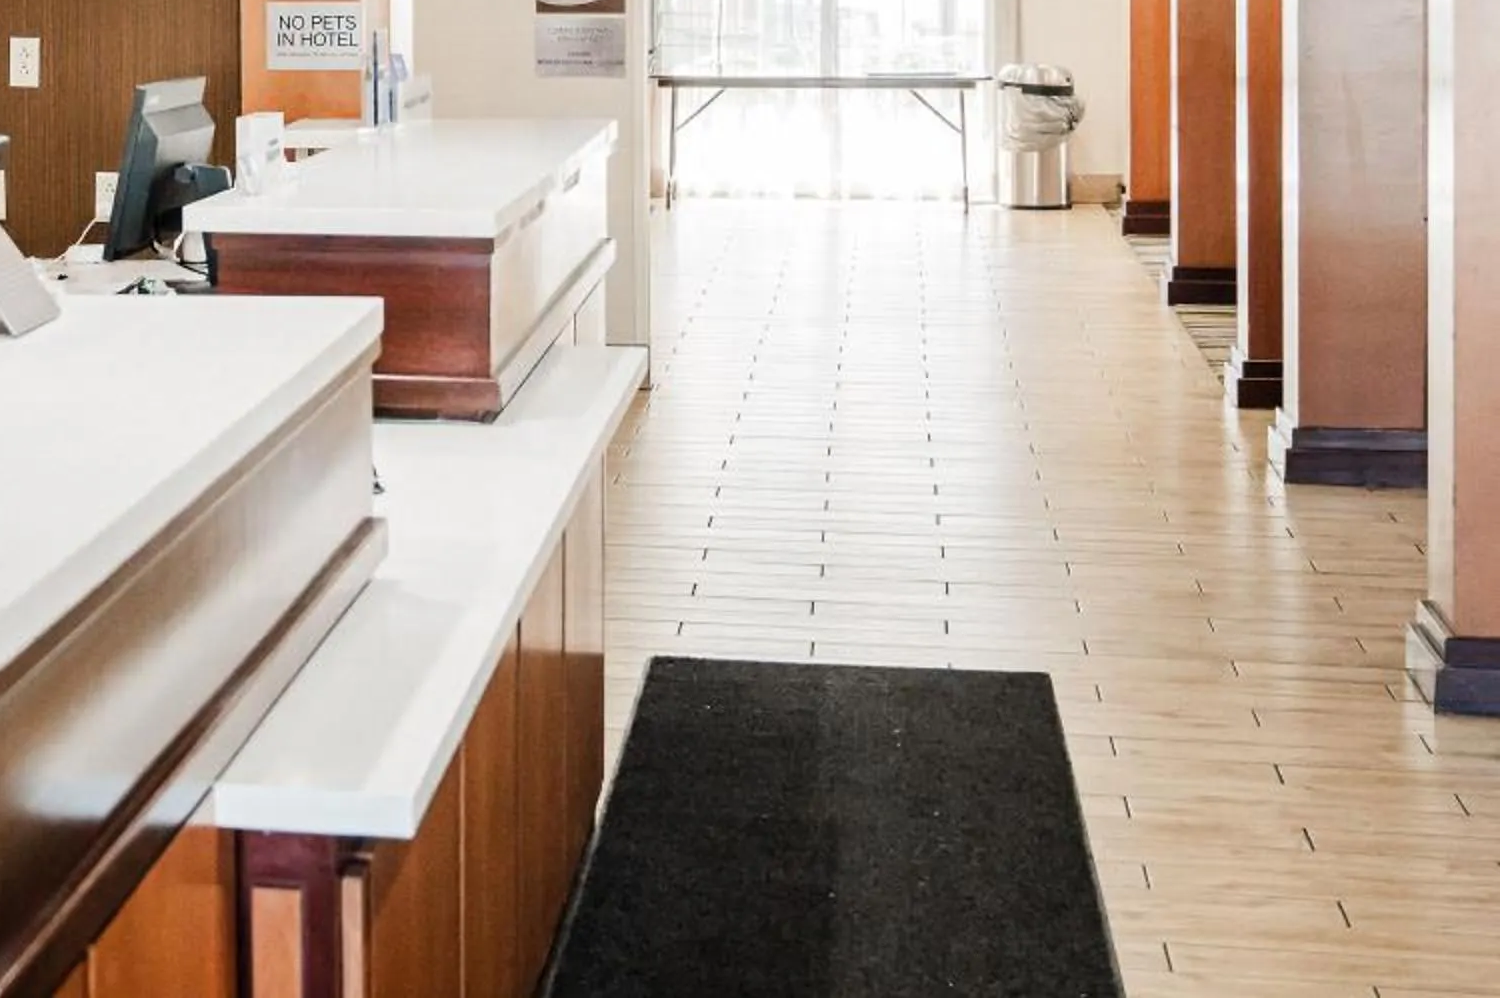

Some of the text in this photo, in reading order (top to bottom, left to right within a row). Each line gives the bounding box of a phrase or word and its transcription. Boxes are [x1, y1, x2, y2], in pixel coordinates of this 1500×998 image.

[279, 15, 357, 31] NO PETS
[277, 32, 359, 47] IN HOTEL
